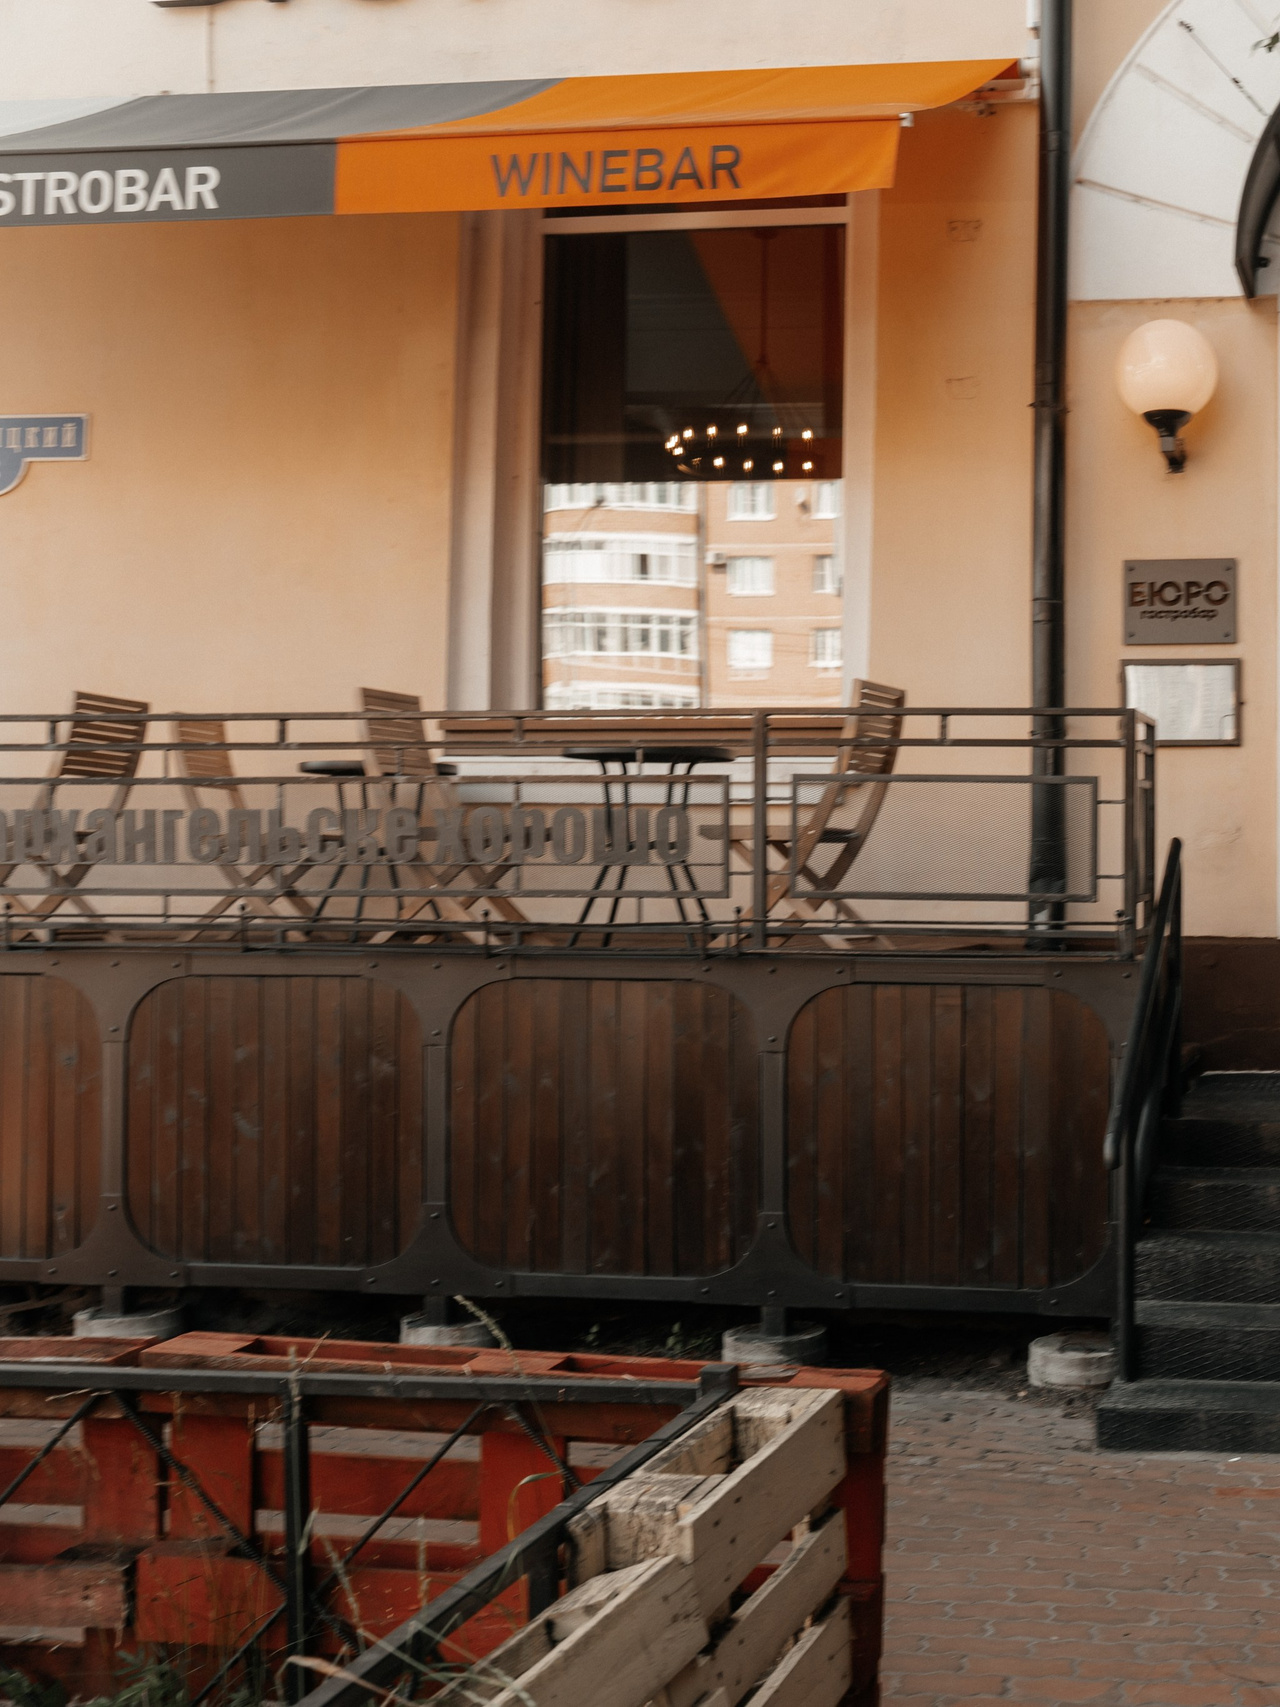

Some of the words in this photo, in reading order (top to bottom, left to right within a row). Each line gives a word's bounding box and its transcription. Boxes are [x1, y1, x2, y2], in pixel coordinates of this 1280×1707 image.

[0, 165, 220, 216] STROBAR
[490, 144, 742, 198] WINEBAR
[0, 807, 418, 864] рхангельске
[431, 806, 691, 865] хорошо
